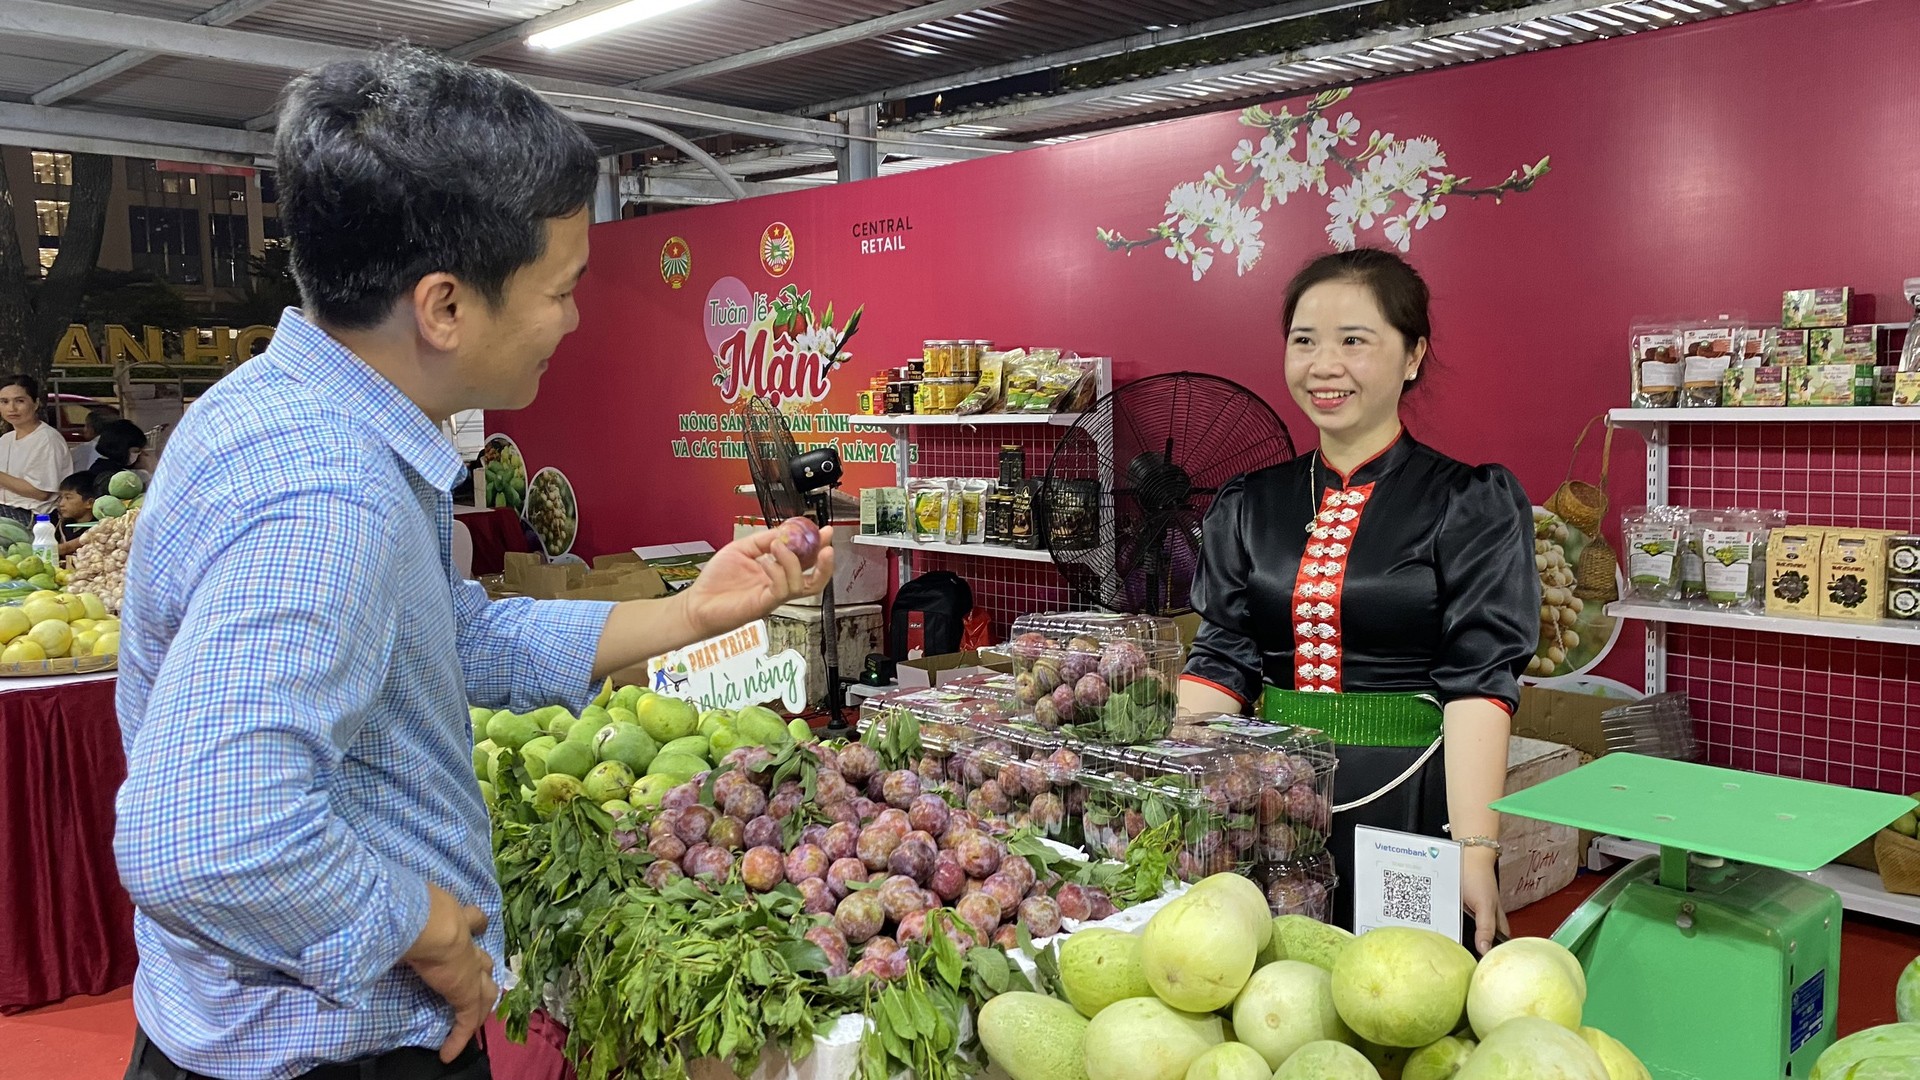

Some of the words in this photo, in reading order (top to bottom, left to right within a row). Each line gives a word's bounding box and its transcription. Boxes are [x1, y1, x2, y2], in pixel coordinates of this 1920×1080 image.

[852, 216, 912, 237] CENTRAL
[861, 235, 906, 254] RETAIL
[709, 297, 748, 326] Tuần
[753, 292, 768, 322] lễ
[719, 329, 829, 407] Mận
[679, 411, 717, 431] NÔNG
[814, 408, 851, 432] TỈNH
[672, 437, 690, 457] VÀ
[692, 437, 717, 457] CÁC
[843, 440, 878, 462] NĂM
[880, 443, 920, 464] 203
[700, 672, 741, 711] nhà
[744, 656, 797, 704] nông
[1375, 842, 1427, 858] Vietcombank
